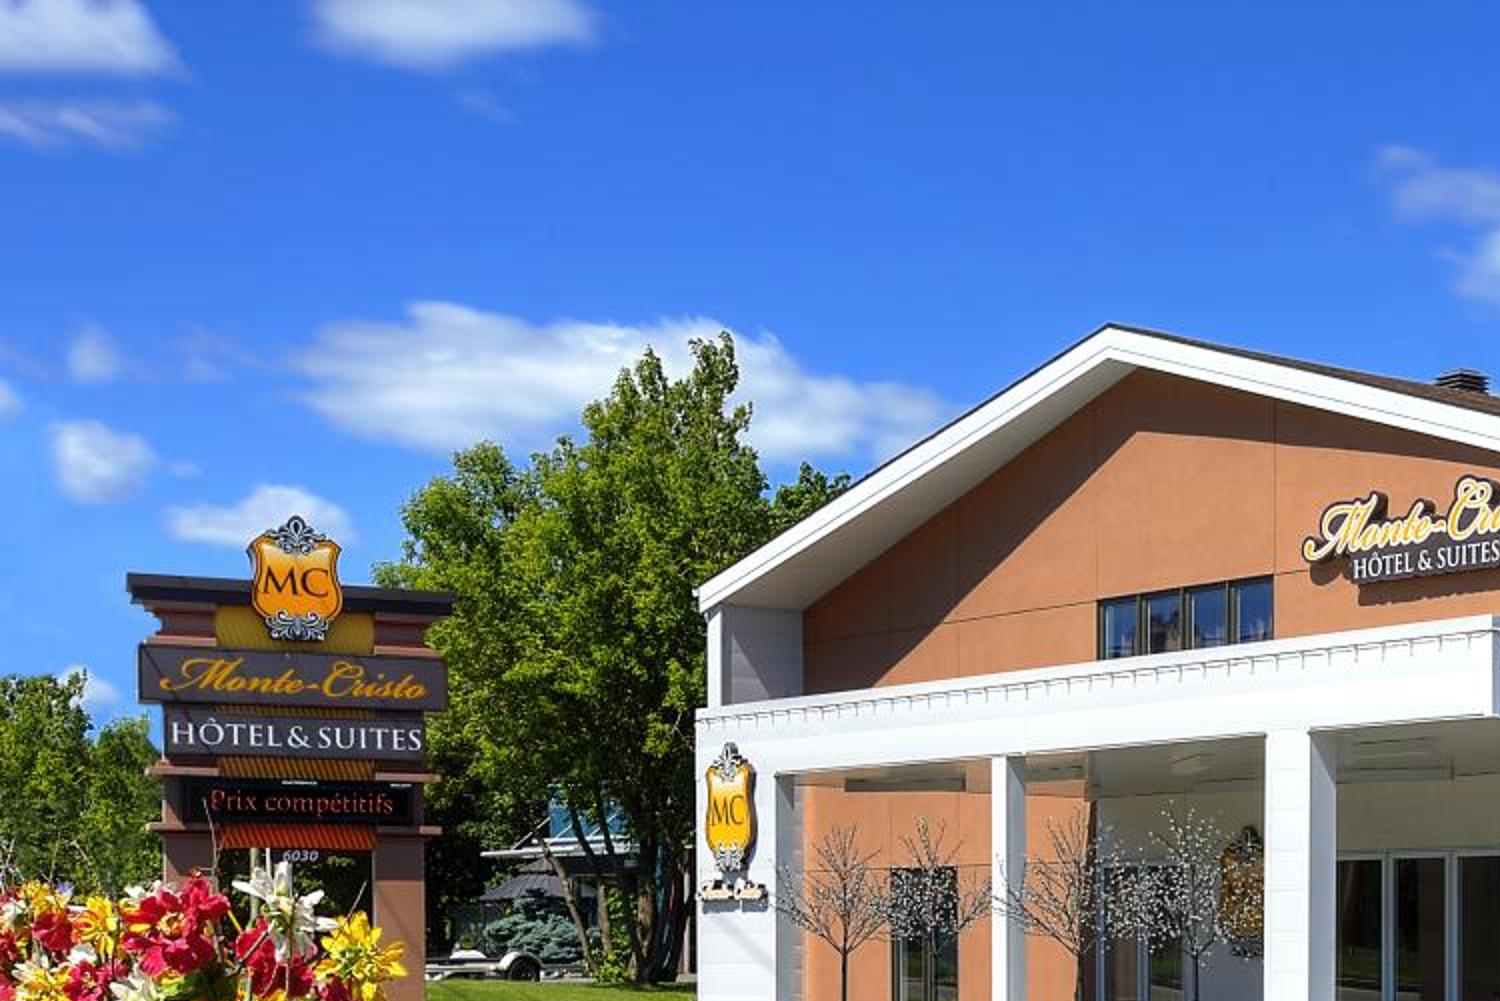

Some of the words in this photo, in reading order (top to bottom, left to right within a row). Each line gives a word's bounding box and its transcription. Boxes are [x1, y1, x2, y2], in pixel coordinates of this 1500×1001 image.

[1353, 551, 1413, 579] HÔTEL
[1418, 549, 1432, 571] &
[1436, 540, 1500, 568] SUITES
[263, 566, 329, 597] MC
[160, 656, 427, 700] Monte-Cristo
[171, 717, 281, 747] HÔTEL
[287, 727, 309, 747] &
[317, 727, 422, 750] SUITES
[210, 789, 256, 811] Prix
[264, 792, 393, 816] compétitifs
[711, 796, 745, 826] MC
[282, 850, 319, 863] 6030
